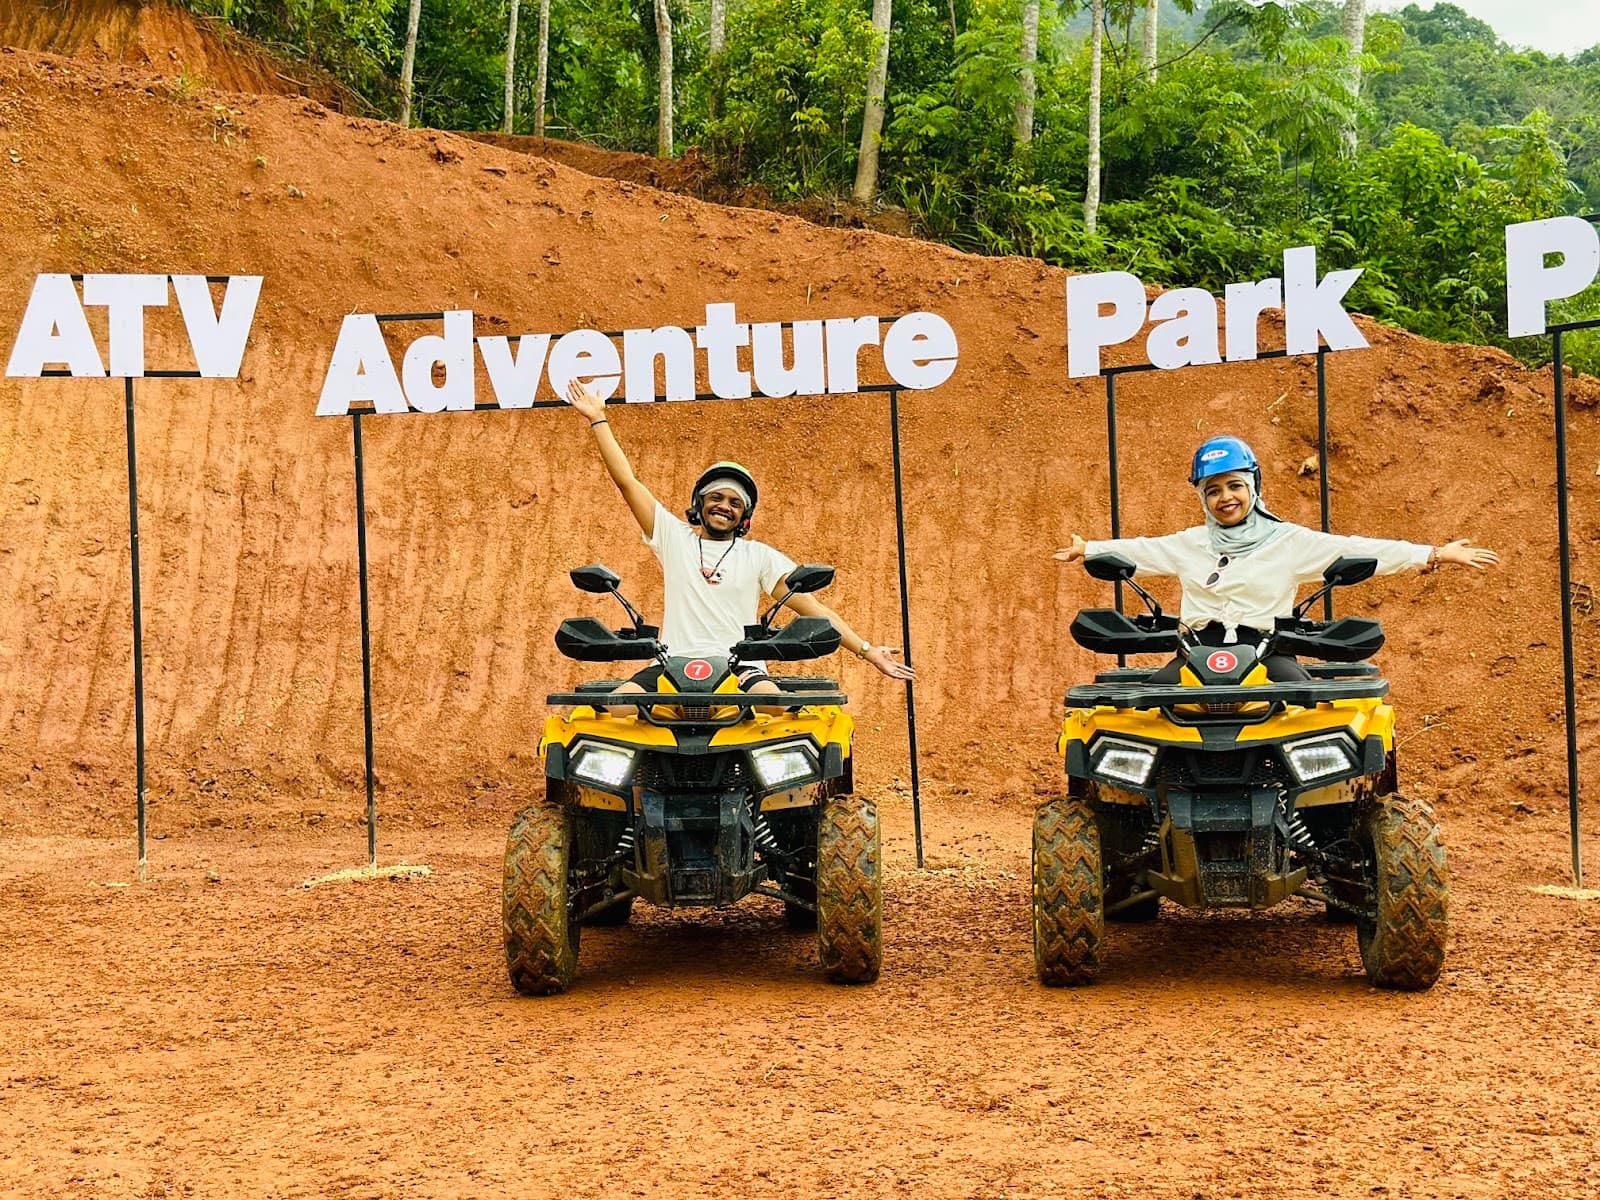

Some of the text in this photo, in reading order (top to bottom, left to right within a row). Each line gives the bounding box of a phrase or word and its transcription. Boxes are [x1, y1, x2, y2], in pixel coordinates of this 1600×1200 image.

[5, 215, 1600, 416] ATV Adventure Park P
[1214, 655, 1230, 669] 8
[691, 664, 705, 677] 7
